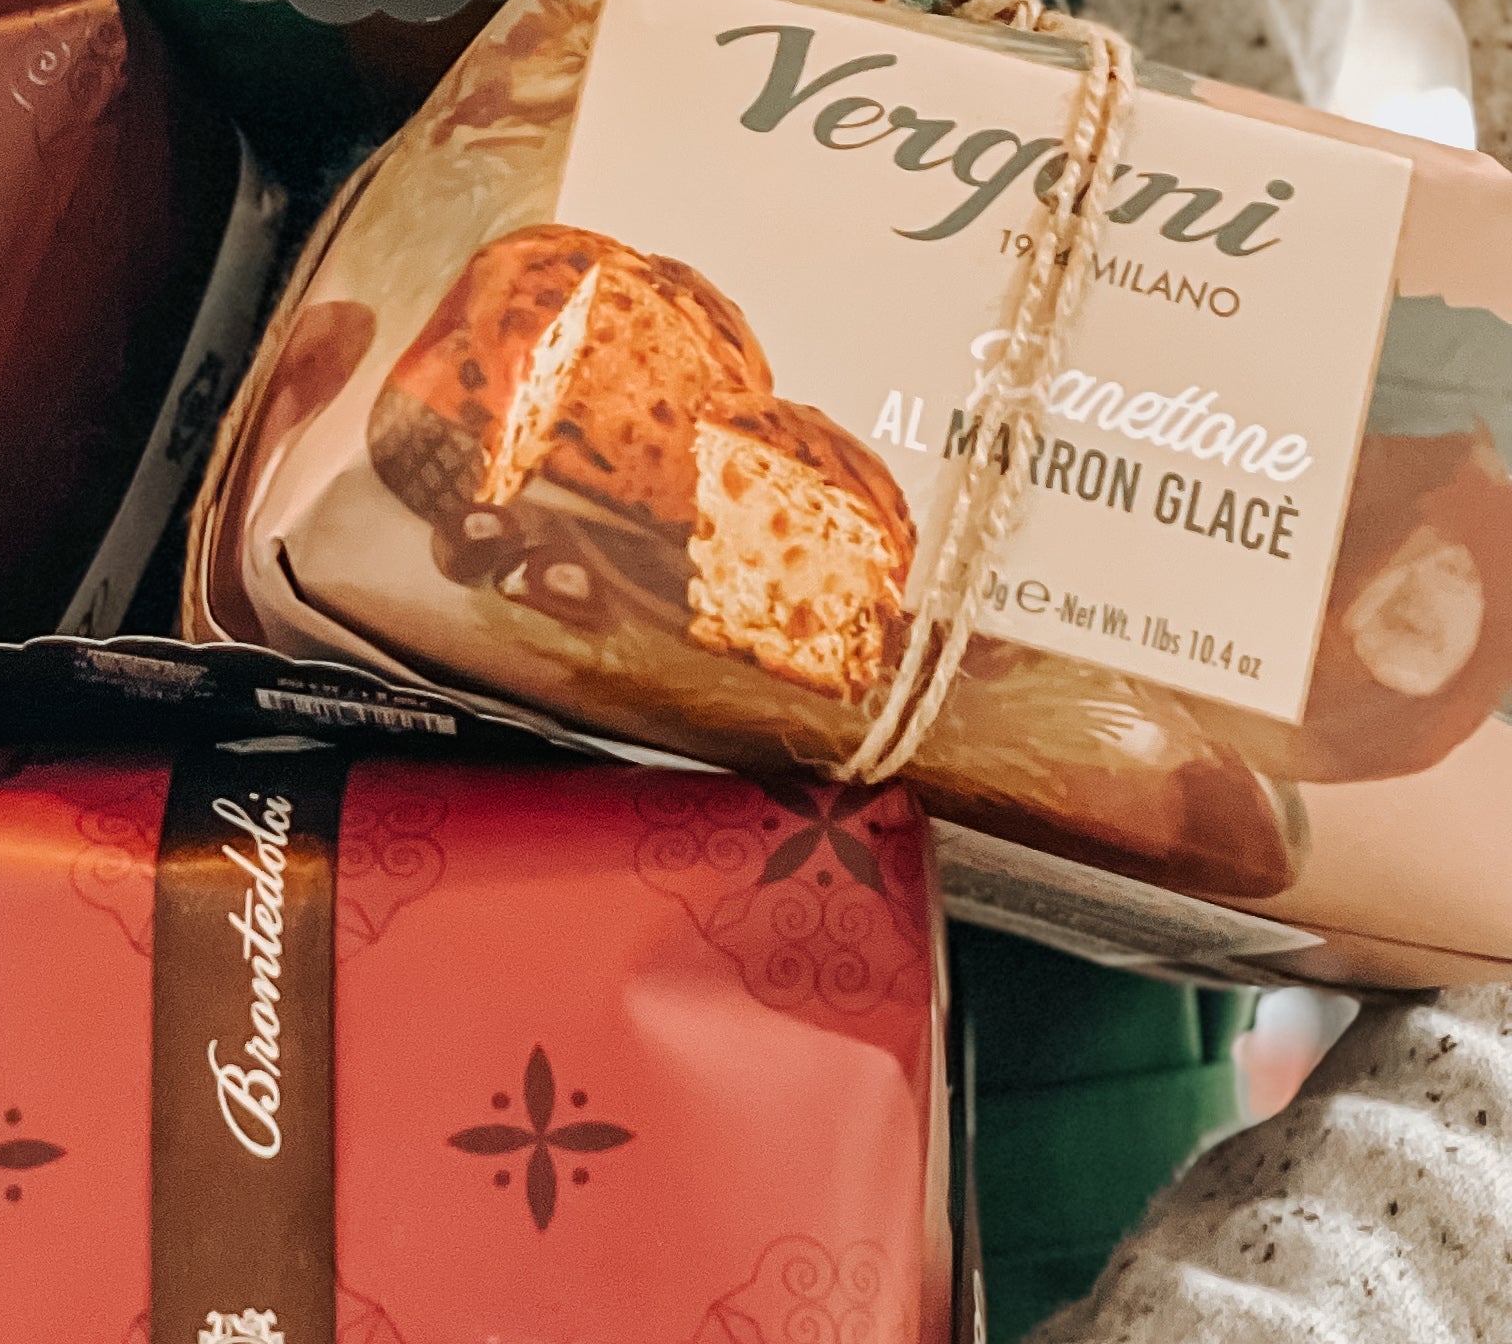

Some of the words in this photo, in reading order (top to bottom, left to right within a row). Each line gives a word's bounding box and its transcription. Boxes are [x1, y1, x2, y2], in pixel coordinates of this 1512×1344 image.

[1090, 252, 1241, 318] MILANO
[871, 389, 928, 453] AL
[1153, 472, 1301, 560] GLACÈ
[1188, 629, 1235, 671] 10.4
[1238, 654, 1265, 680] oz
[206, 790, 294, 1160] Brontedolci
